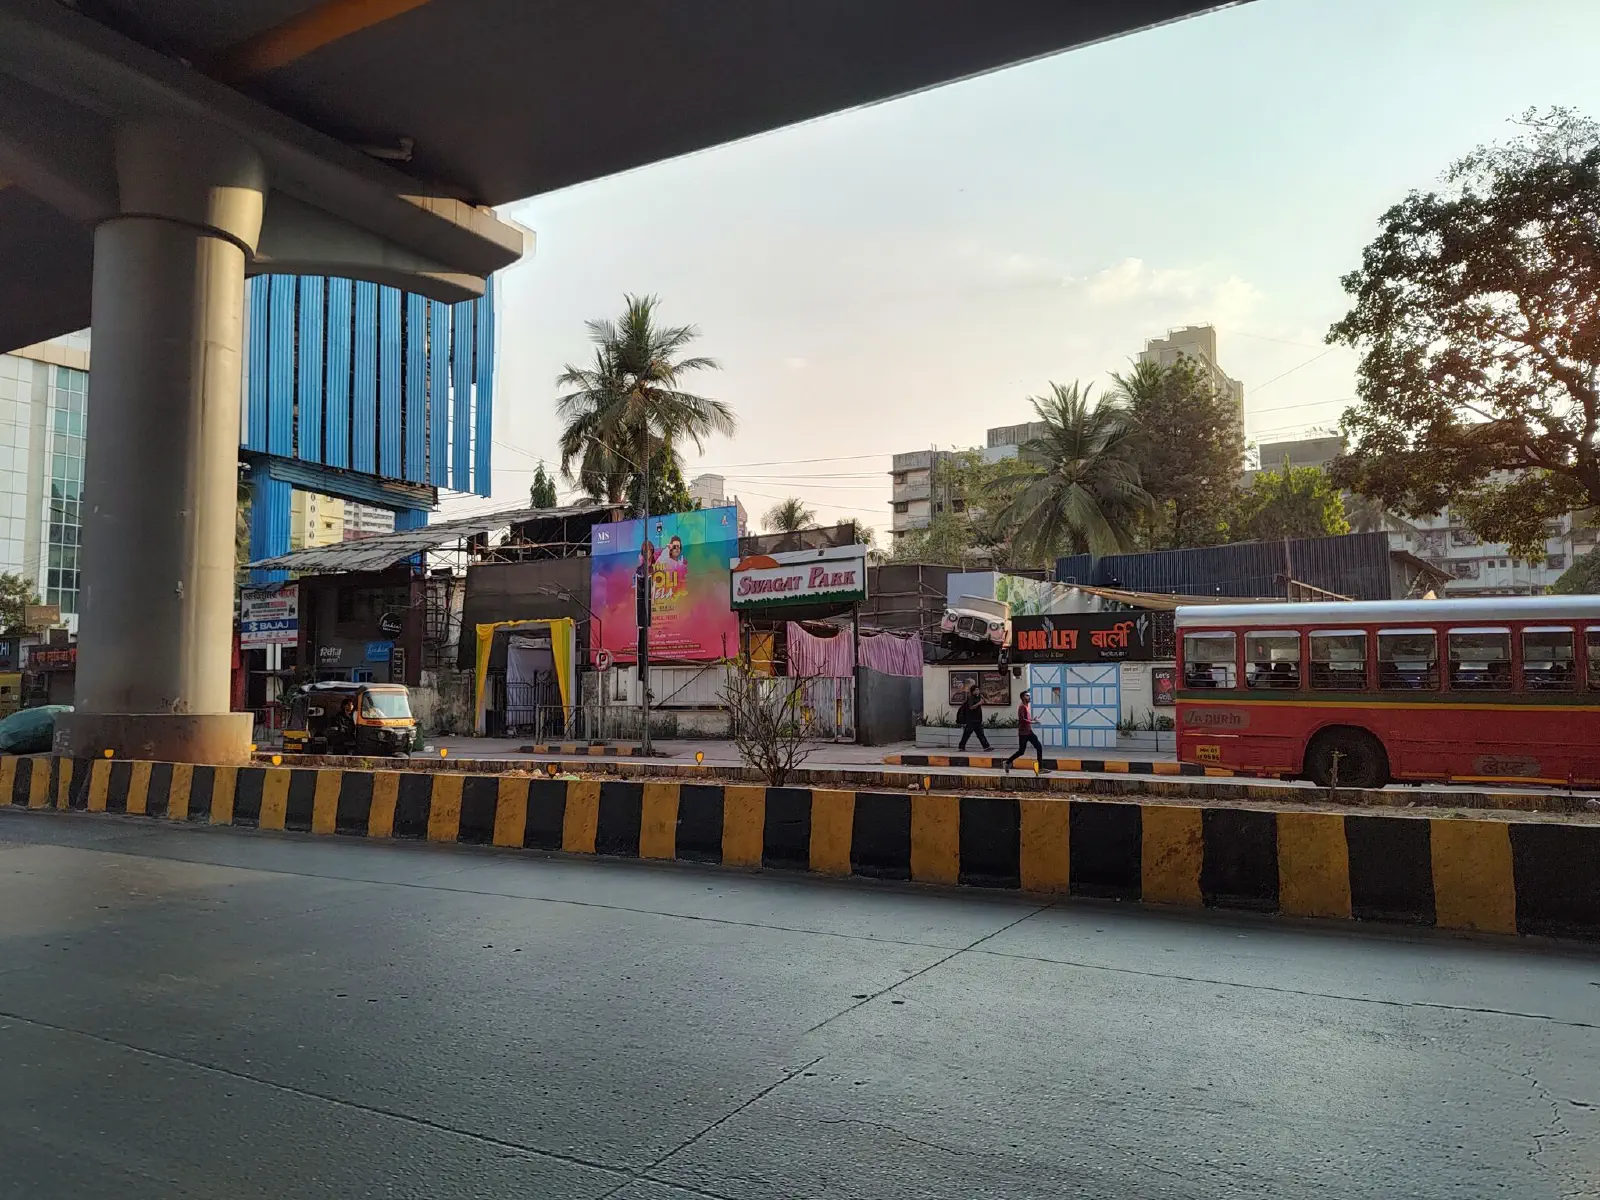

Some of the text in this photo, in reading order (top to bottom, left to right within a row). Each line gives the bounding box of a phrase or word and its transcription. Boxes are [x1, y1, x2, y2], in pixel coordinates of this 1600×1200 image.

[737, 567, 856, 596] SWAGAT PARK
[260, 621, 289, 630] BAJAJ
[1089, 620, 1134, 648] बार्ली
[1018, 630, 1079, 650] BARLEY
